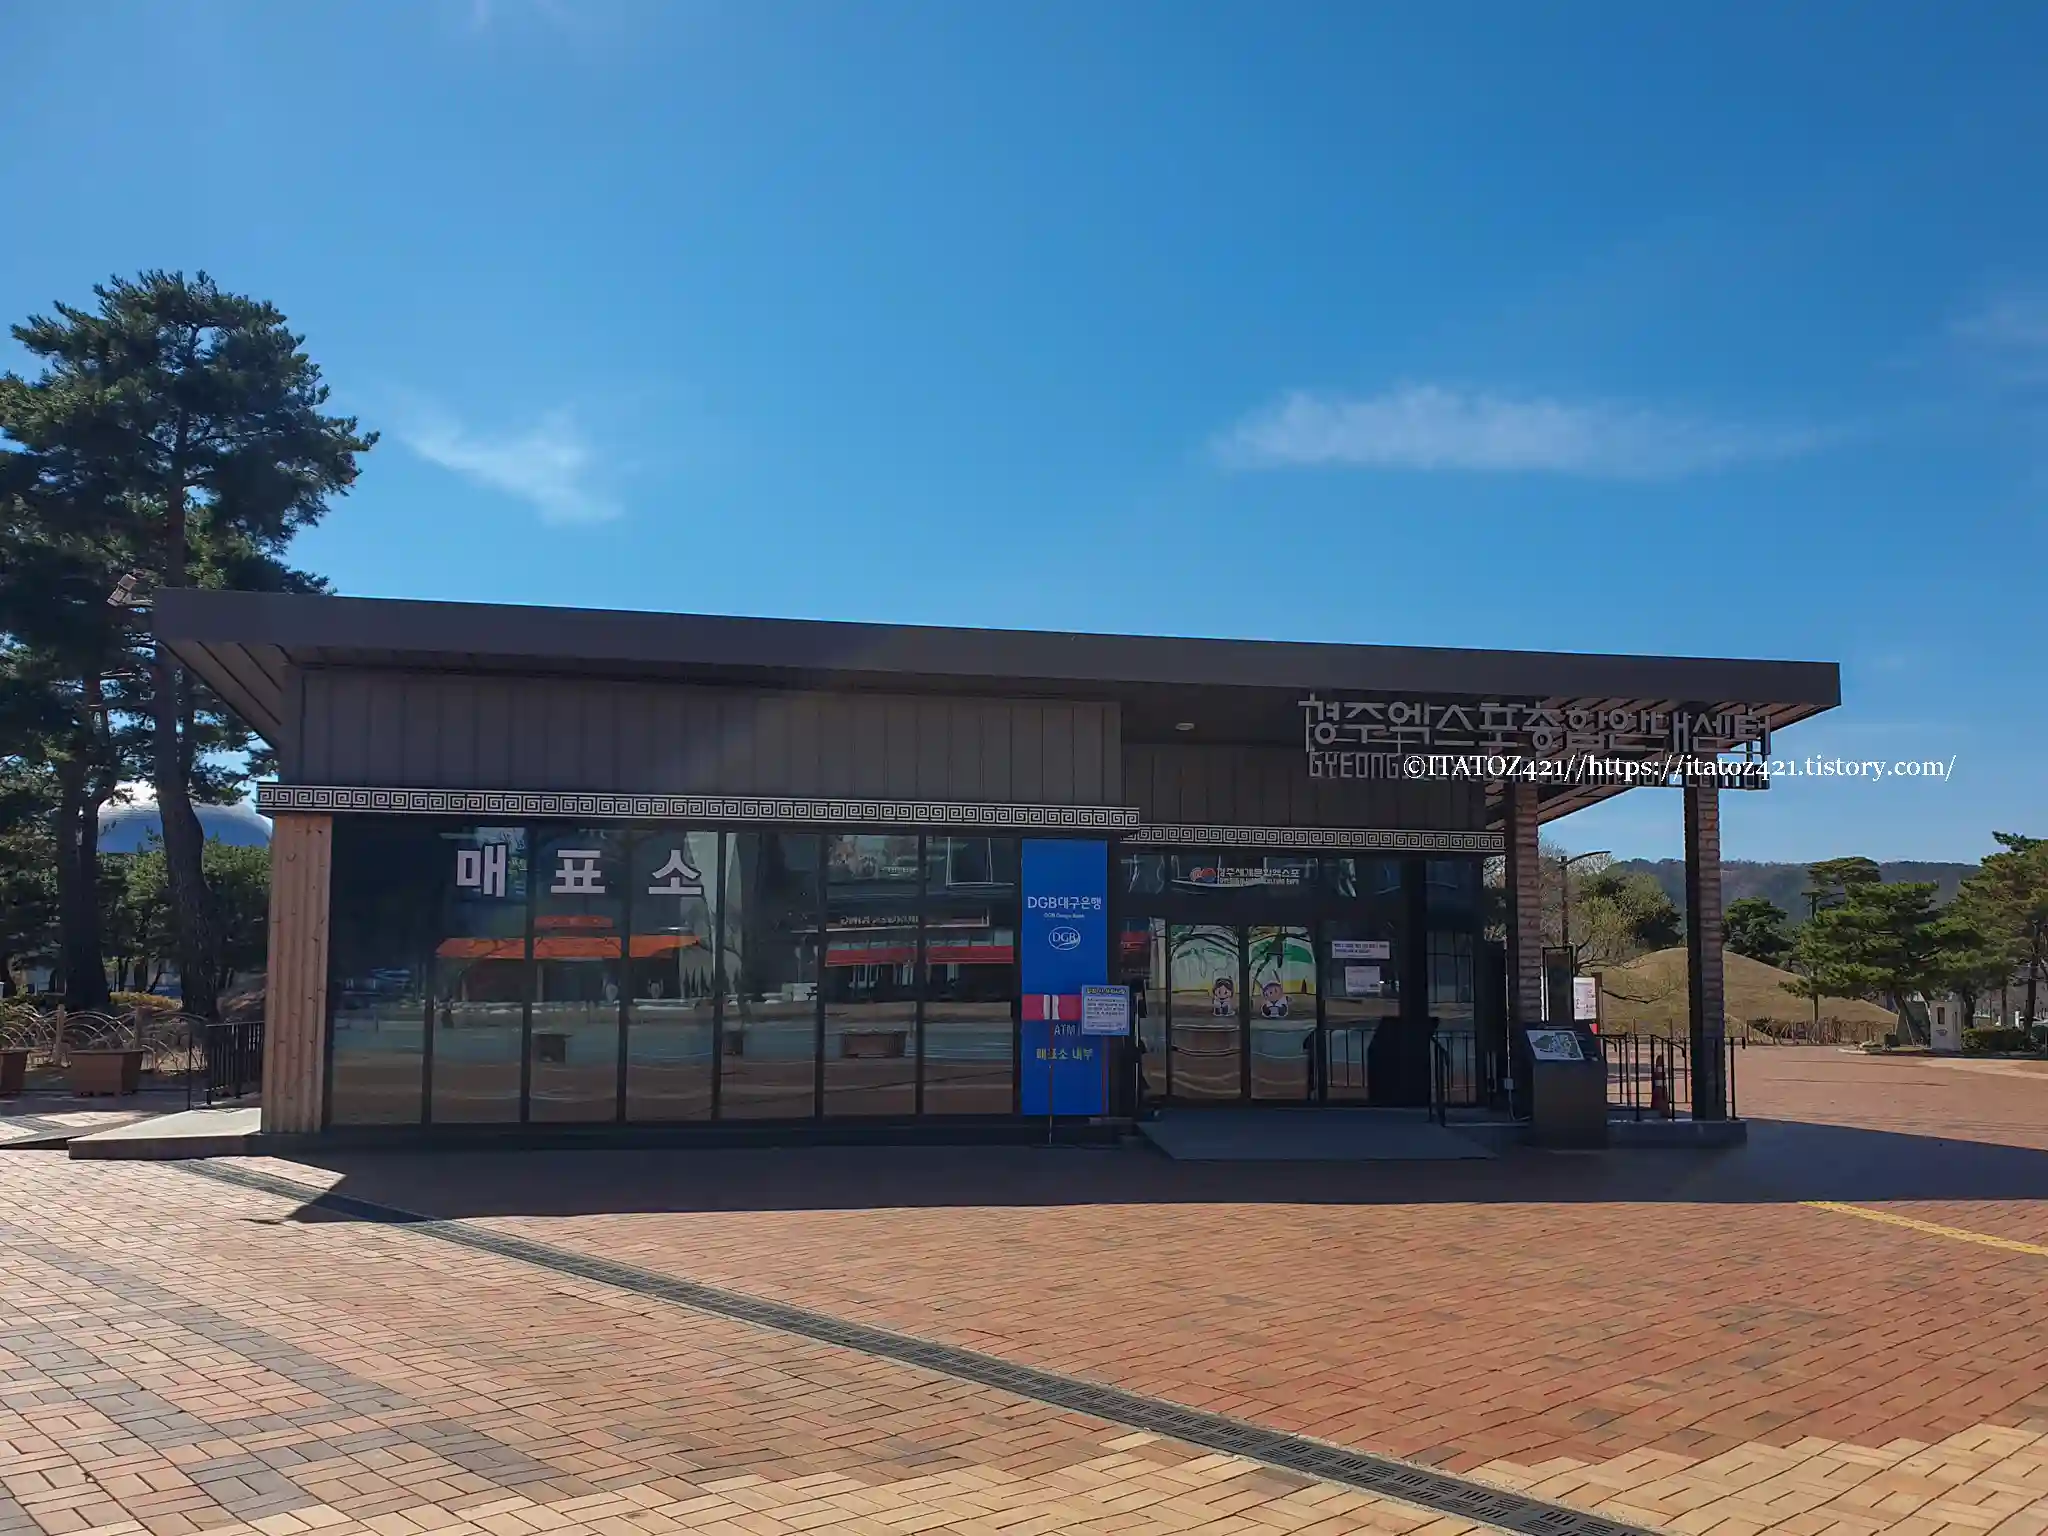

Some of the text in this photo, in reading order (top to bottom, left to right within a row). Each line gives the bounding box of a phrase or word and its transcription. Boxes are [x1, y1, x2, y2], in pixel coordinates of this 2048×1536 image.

[457, 845, 702, 897] 매 표 소
[1027, 896, 1102, 910] DGB대구은행
[1052, 932, 1077, 942] DGB
[1072, 1046, 1094, 1061] 내부
